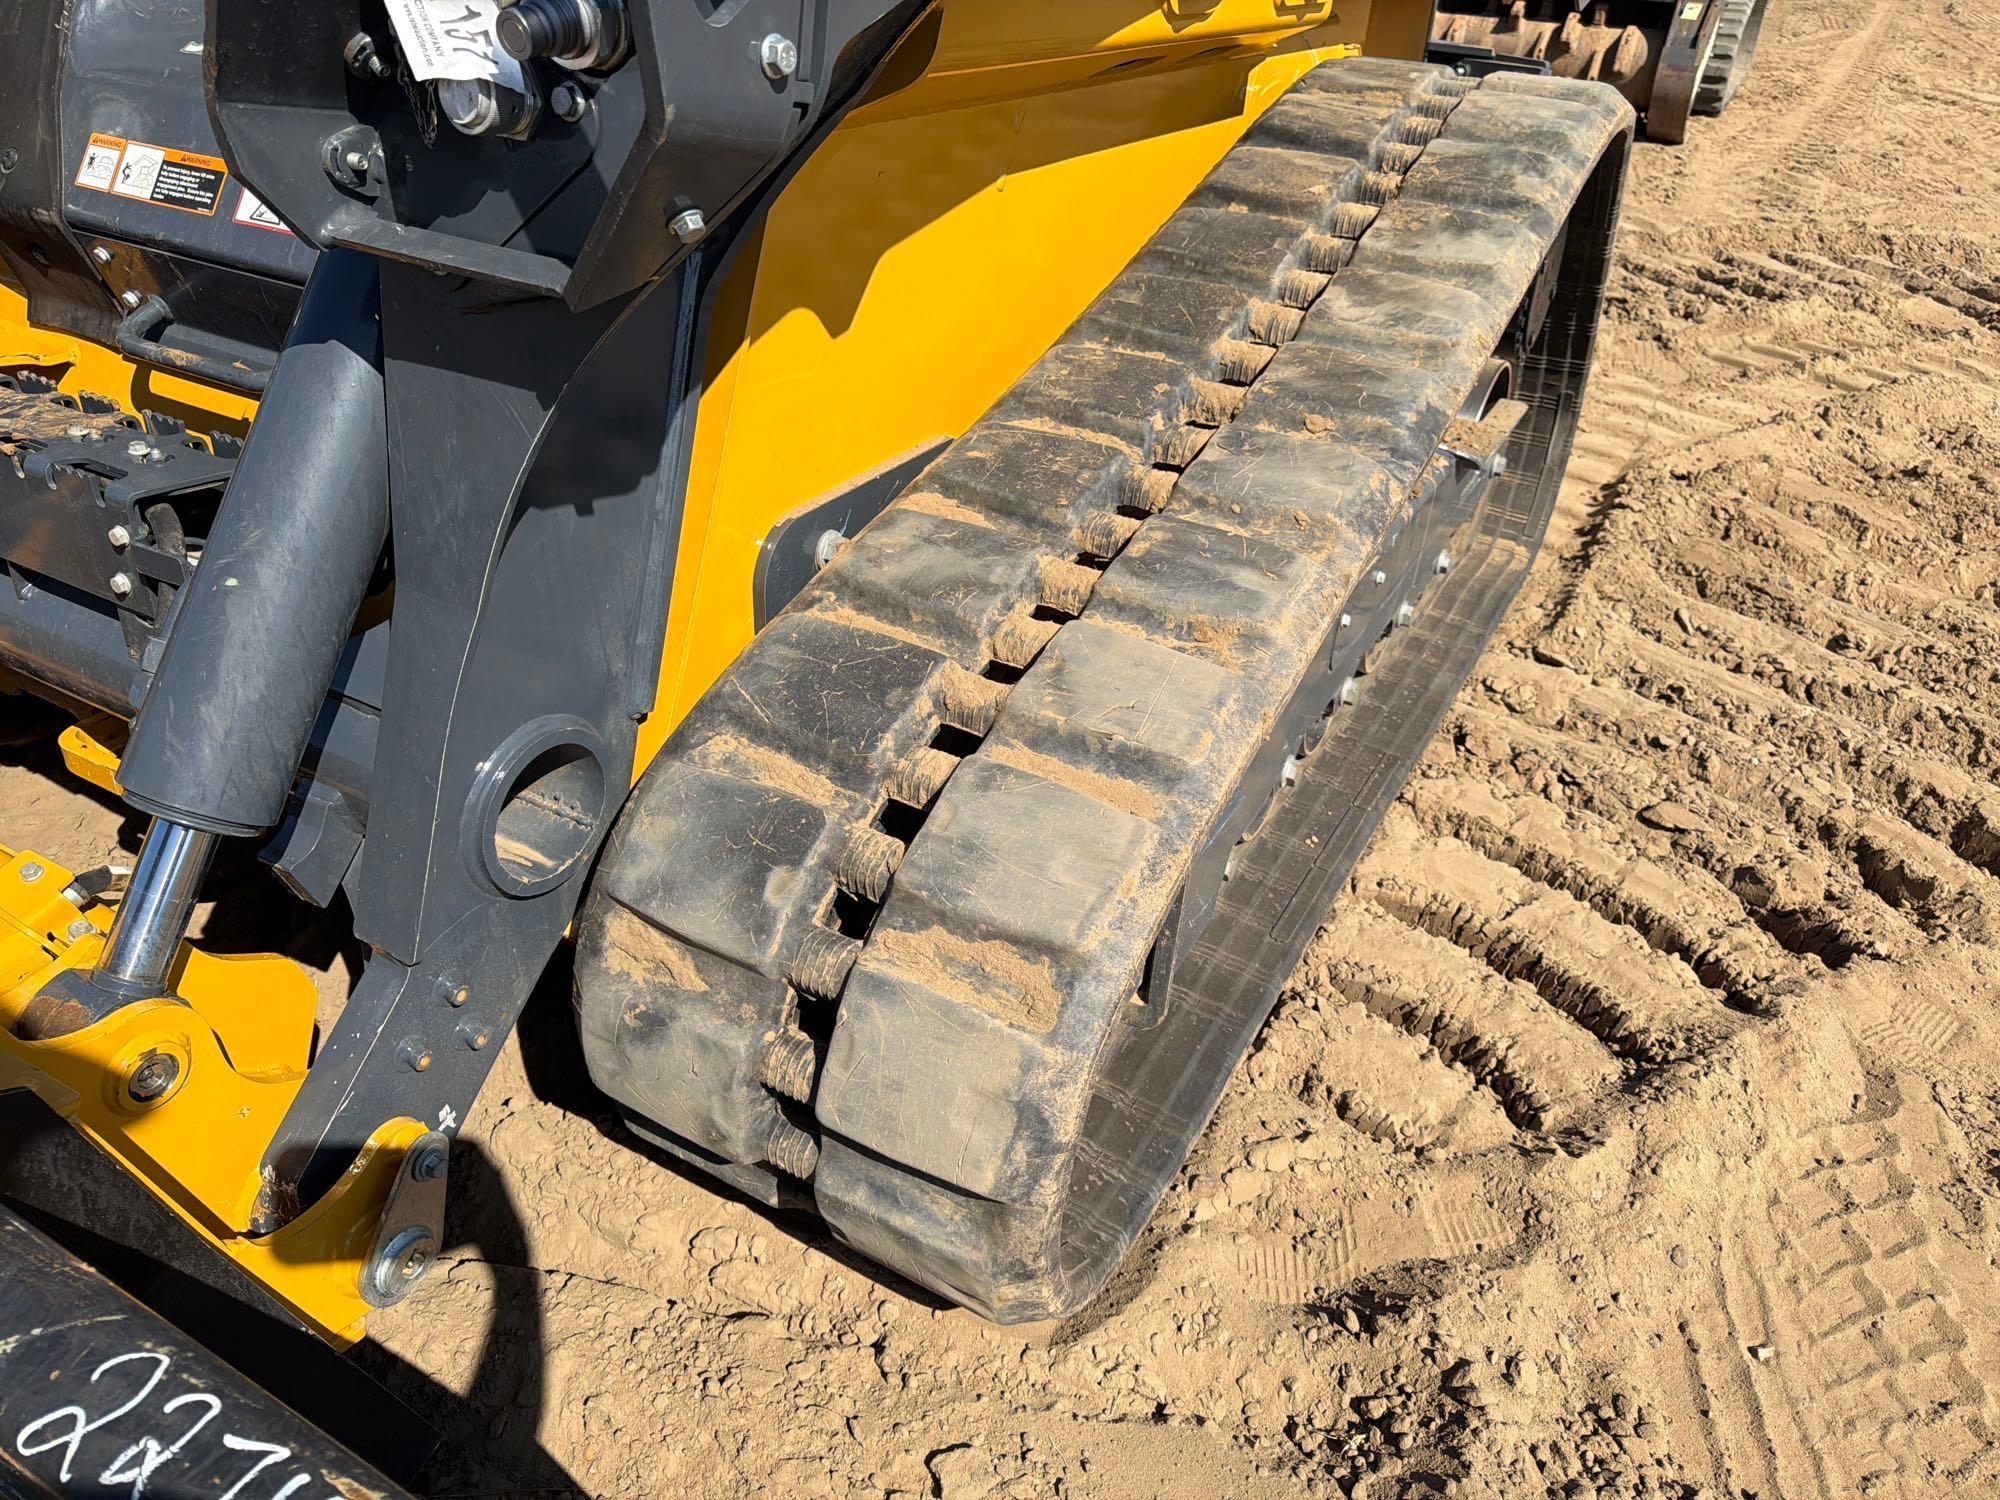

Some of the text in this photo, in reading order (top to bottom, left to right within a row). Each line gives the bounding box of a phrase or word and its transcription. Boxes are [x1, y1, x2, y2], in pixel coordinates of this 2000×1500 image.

[423, 23, 446, 57] COMPANY
[98, 138, 122, 149] WARNING
[187, 156, 211, 167] WARNING
